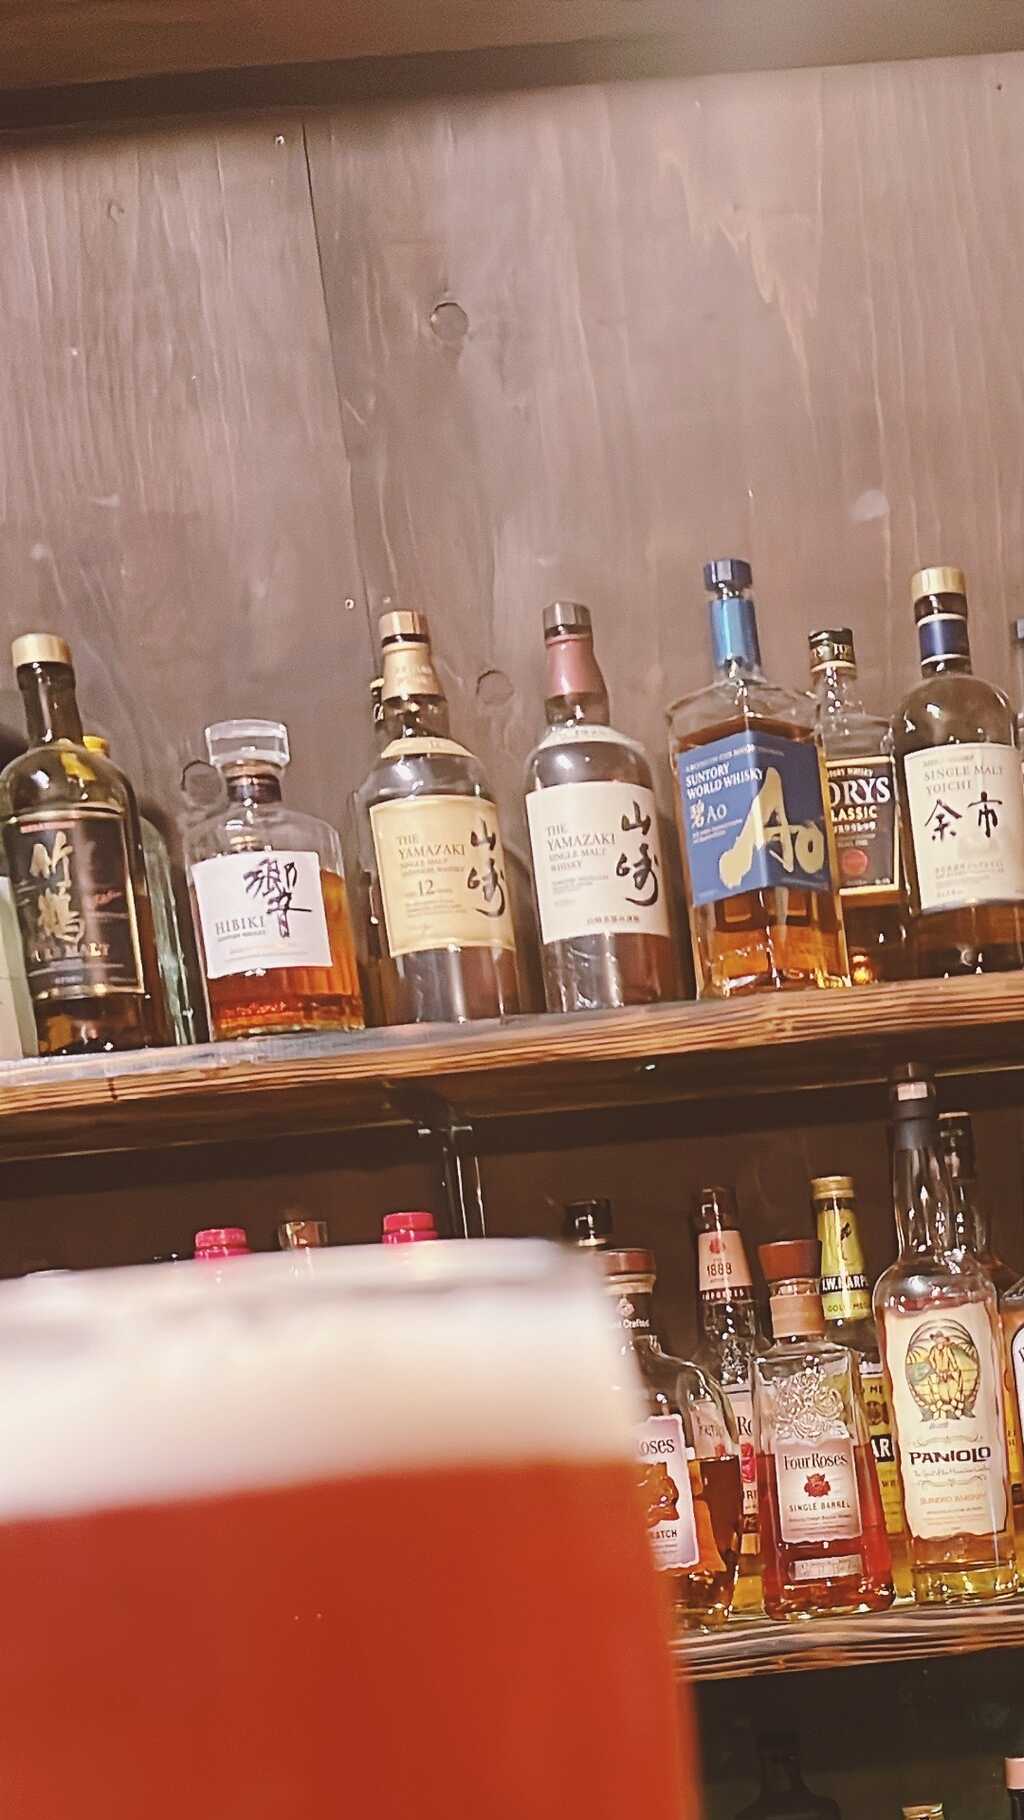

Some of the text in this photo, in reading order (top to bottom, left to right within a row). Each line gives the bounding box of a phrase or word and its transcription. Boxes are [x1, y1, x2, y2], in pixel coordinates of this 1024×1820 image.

[686, 762, 730, 788] SUNTORY
[687, 767, 763, 801] WORLD WHISKY
[925, 765, 1003, 782] SINGLE MALT
[829, 776, 891, 807] ORYS
[831, 804, 878, 823] LASSIC
[924, 791, 1003, 842] 余市
[399, 844, 466, 860] YAMAZAKI
[548, 833, 616, 851] YAMAZAKI
[616, 800, 660, 907] 山崎
[467, 818, 506, 917] 山崎
[243, 859, 312, 938] 響
[418, 879, 435, 897] 12
[215, 915, 265, 936] HIBIKI
[641, 1437, 675, 1457] oses
[909, 1445, 992, 1466] PANIOLO
[784, 1452, 849, 1472] Four Roses
[789, 1500, 851, 1513] SINGLE BARREL
